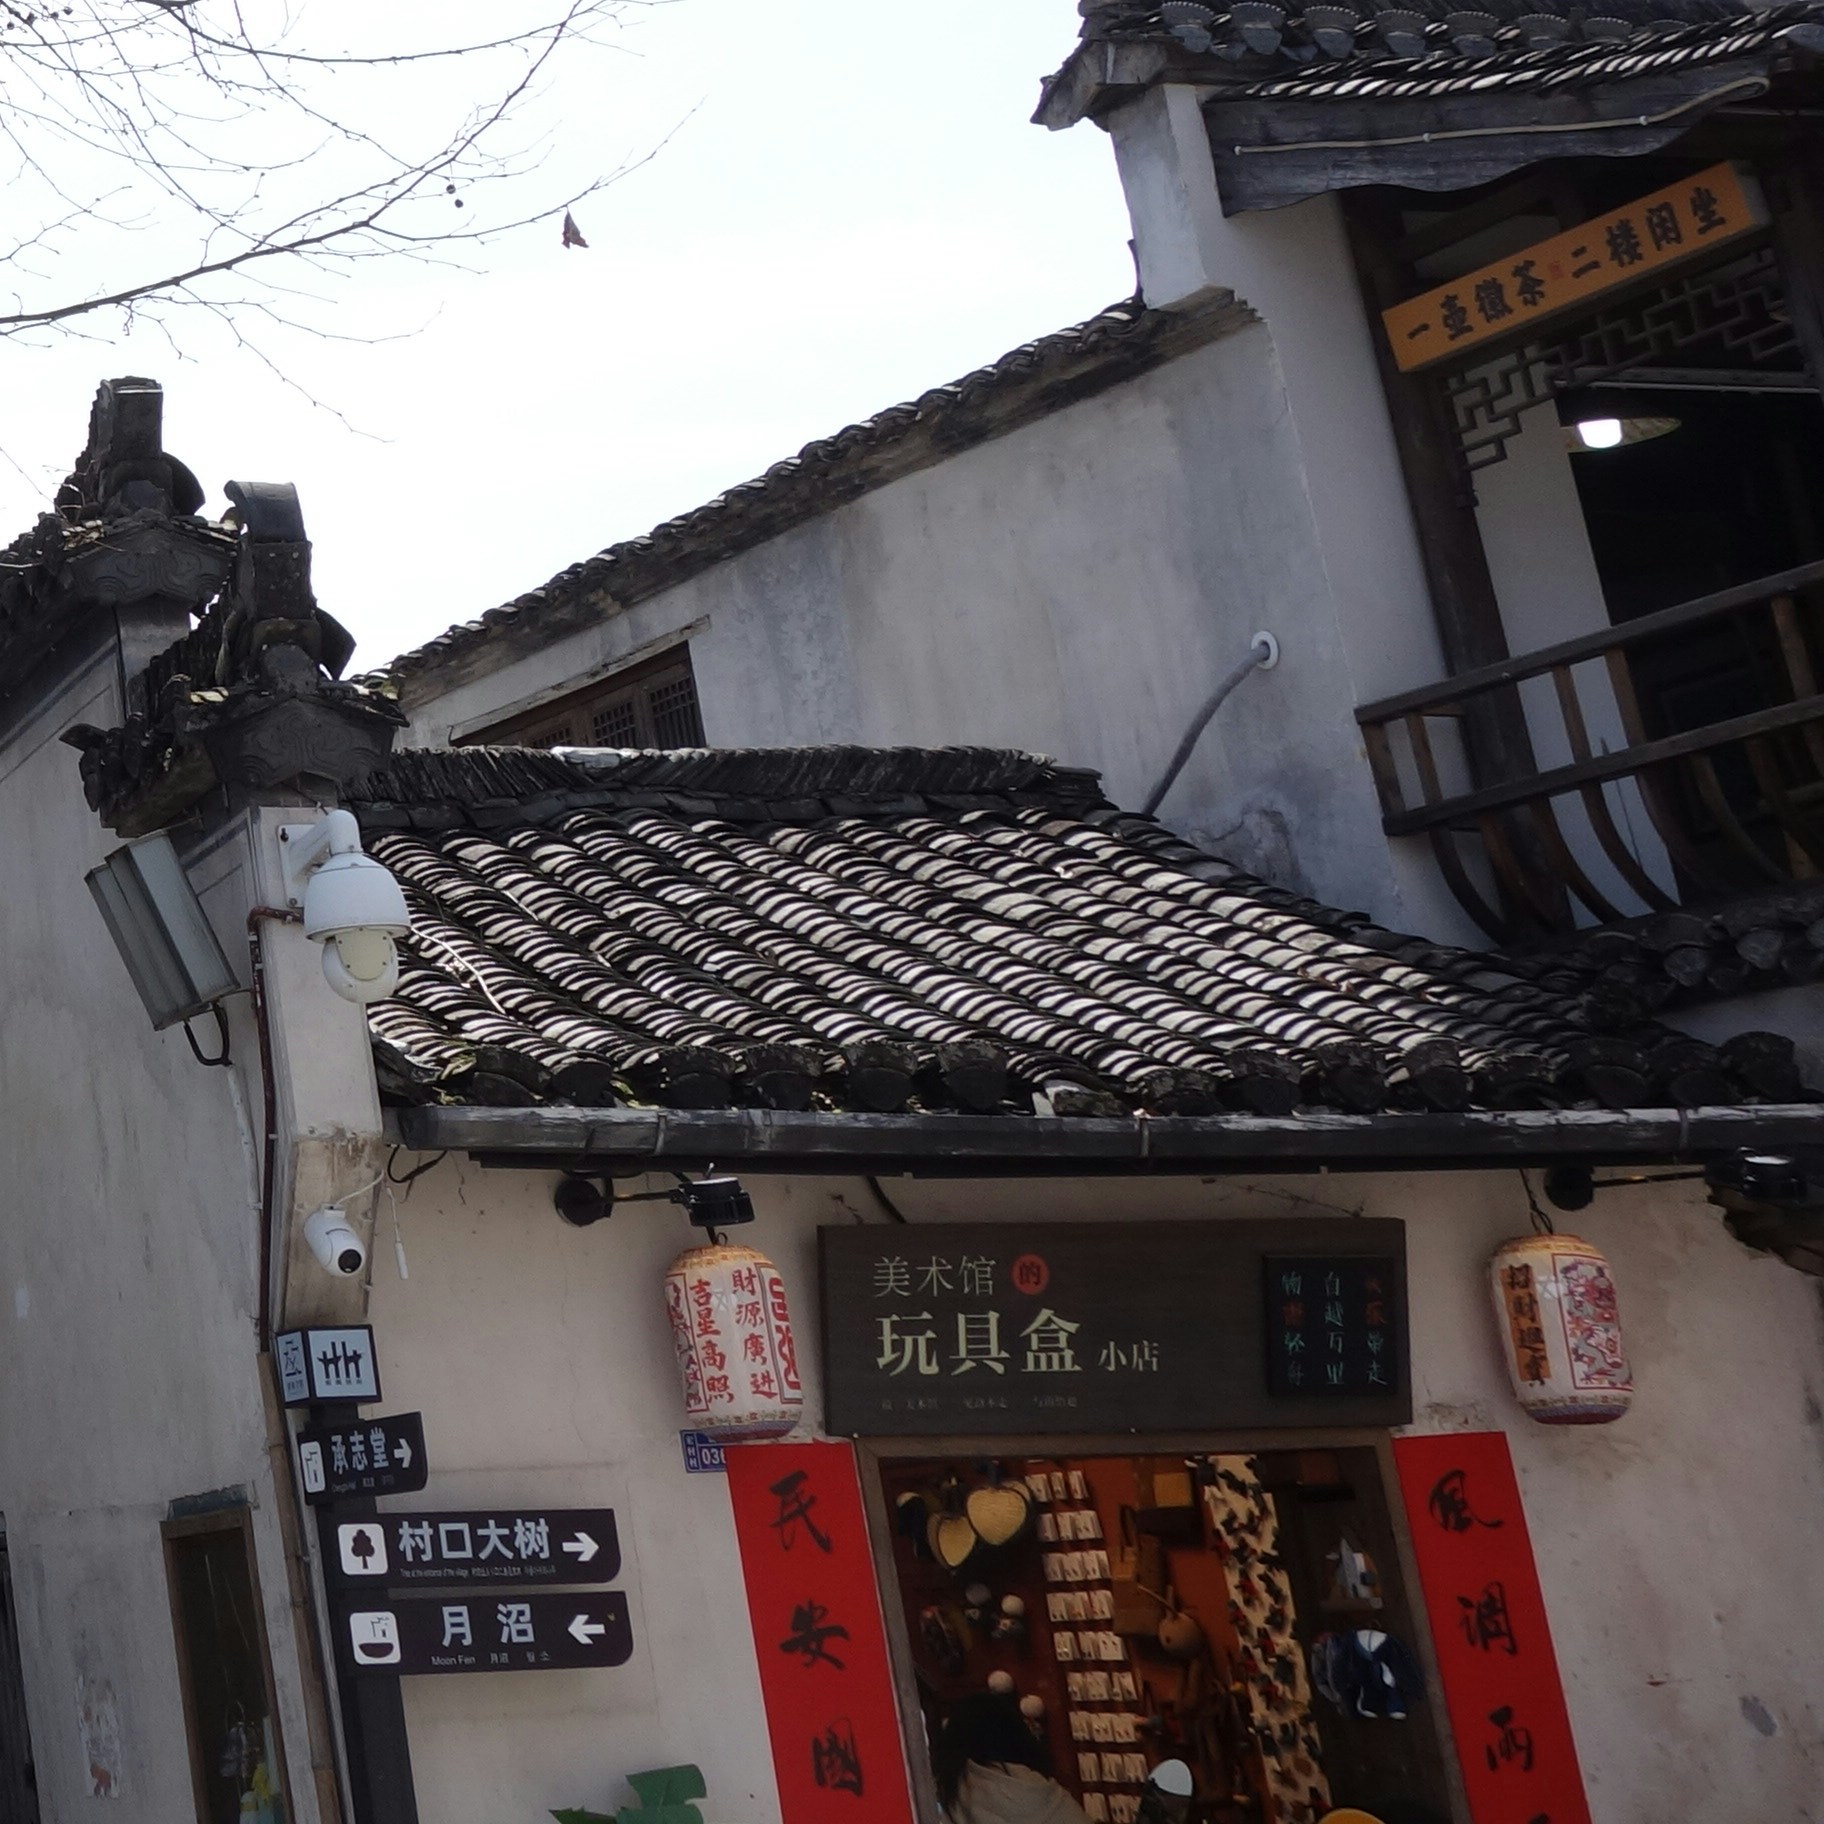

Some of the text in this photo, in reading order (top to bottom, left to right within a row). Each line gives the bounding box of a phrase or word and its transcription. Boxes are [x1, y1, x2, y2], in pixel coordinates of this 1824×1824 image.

[1407, 259, 1545, 340] 一壶徽茶
[873, 1255, 1042, 1298] 美术馆 的
[690, 1278, 735, 1404] 吉星高照
[874, 1307, 1160, 1377] 玩具盒 小店
[330, 1426, 390, 1475] 承志堂
[398, 1518, 550, 1563] 村口大树
[441, 1602, 535, 1648] 月沼
